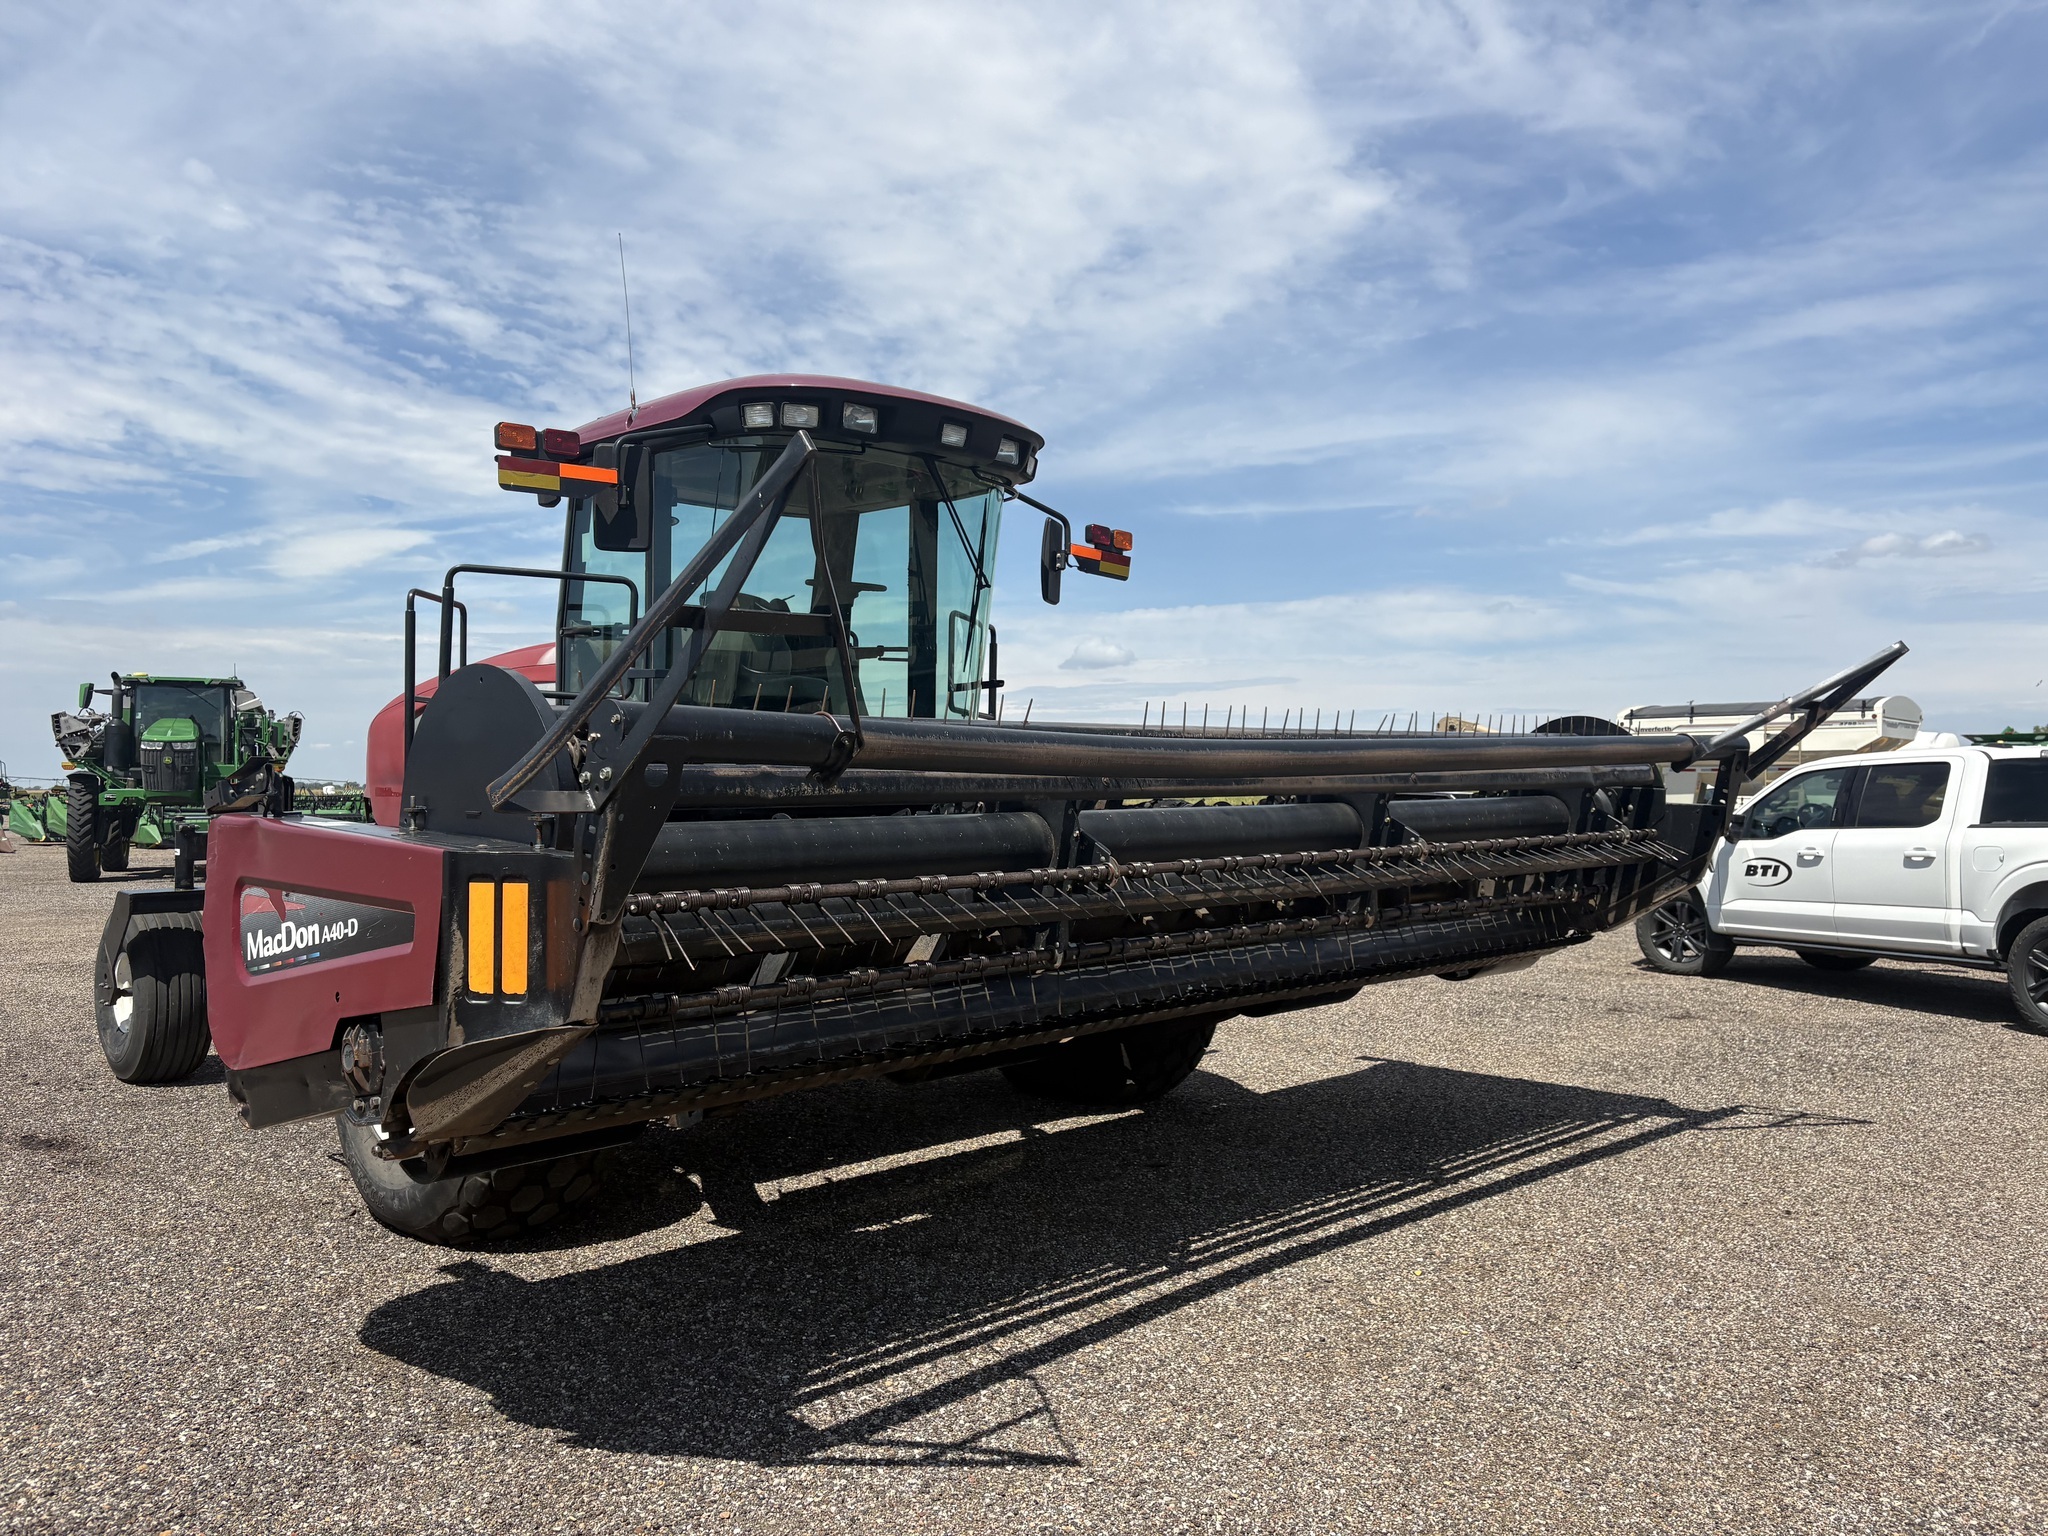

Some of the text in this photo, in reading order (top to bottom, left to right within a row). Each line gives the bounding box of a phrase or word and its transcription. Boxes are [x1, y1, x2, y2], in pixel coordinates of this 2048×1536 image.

[1744, 864, 1780, 877] BTI
[247, 918, 358, 960] MacDon A40-D
